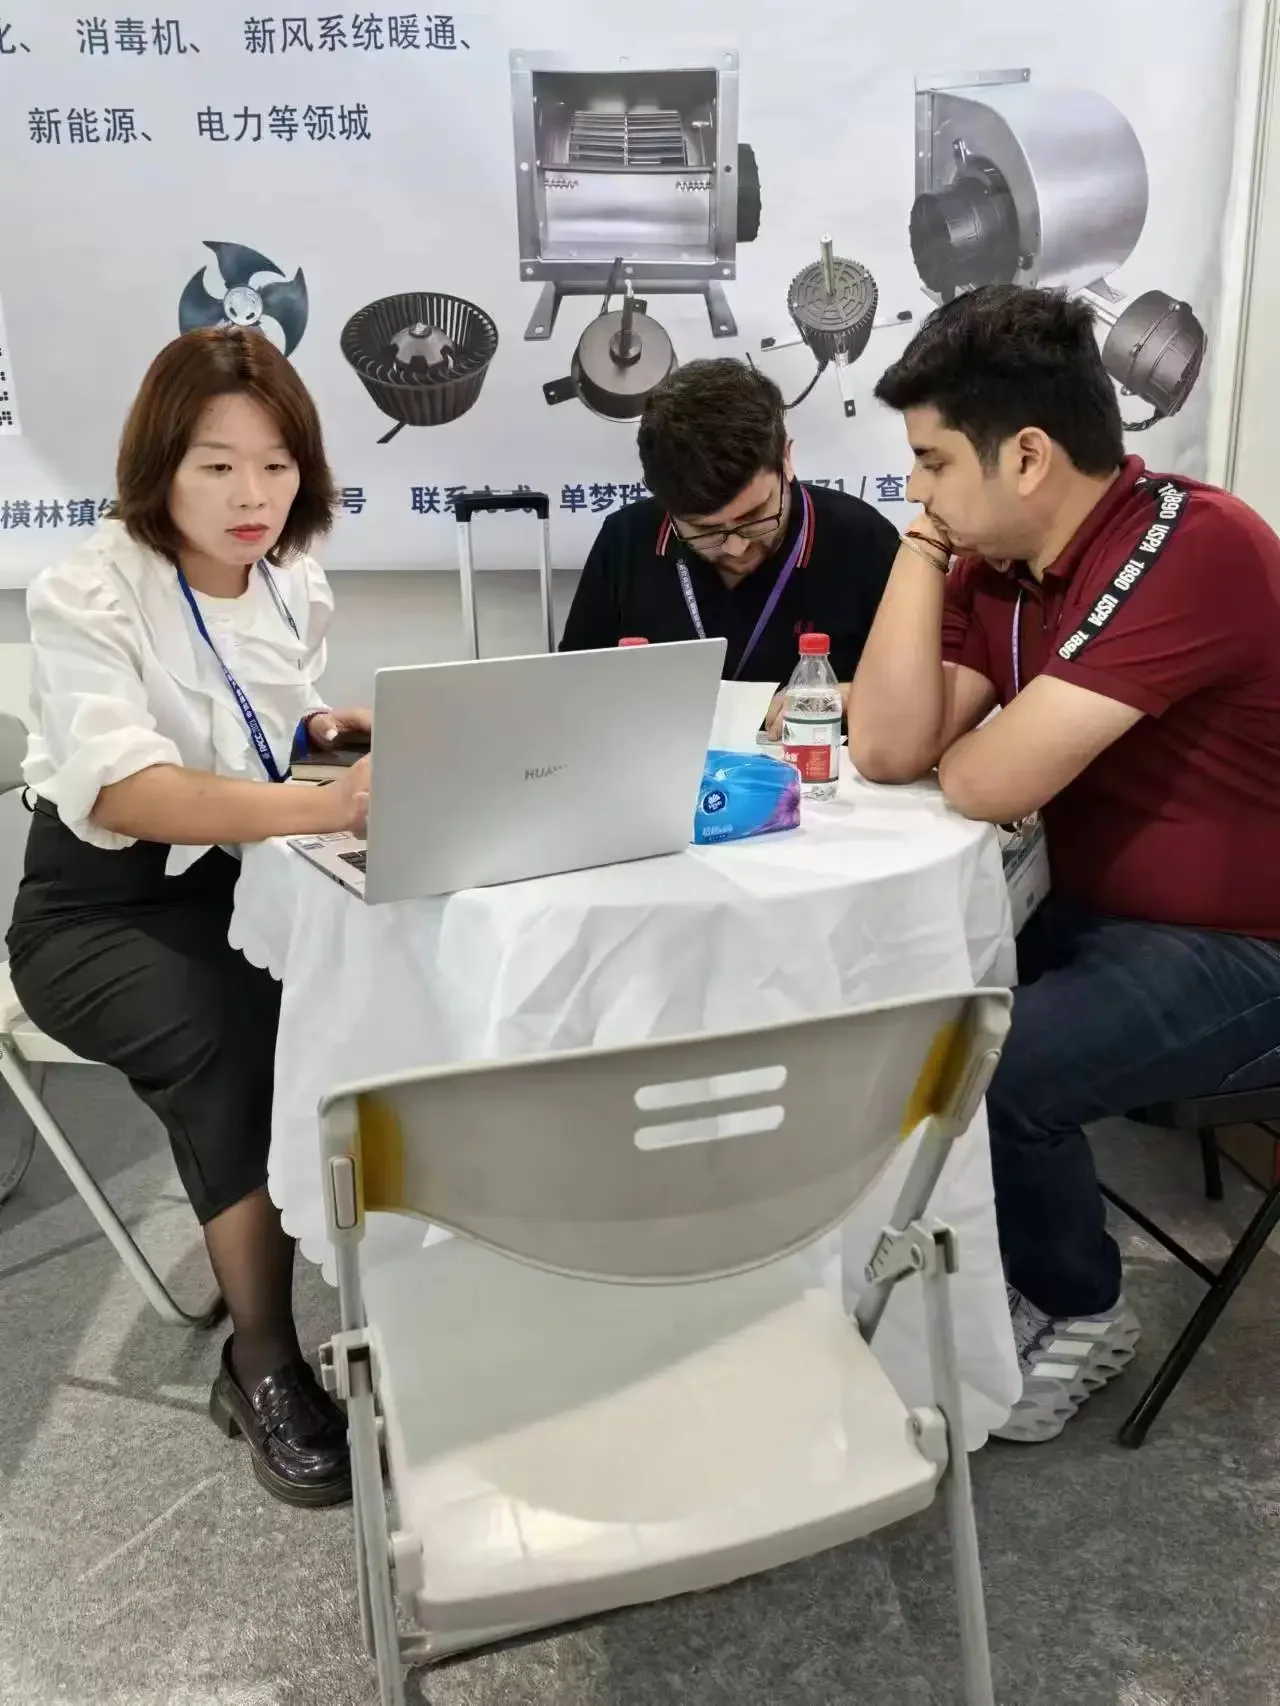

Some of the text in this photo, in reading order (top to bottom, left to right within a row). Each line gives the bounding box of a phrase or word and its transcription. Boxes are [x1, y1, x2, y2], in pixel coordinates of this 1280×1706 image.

[77, 17, 201, 56] 消毒机、
[244, 13, 471, 55] 新风系统暖通、
[28, 103, 372, 145] 新能源、 电力等领城
[1139, 523, 1170, 553] USPA
[1113, 559, 1145, 591] 1890
[1087, 593, 1119, 627] USPA
[1058, 630, 1090, 660] 1890
